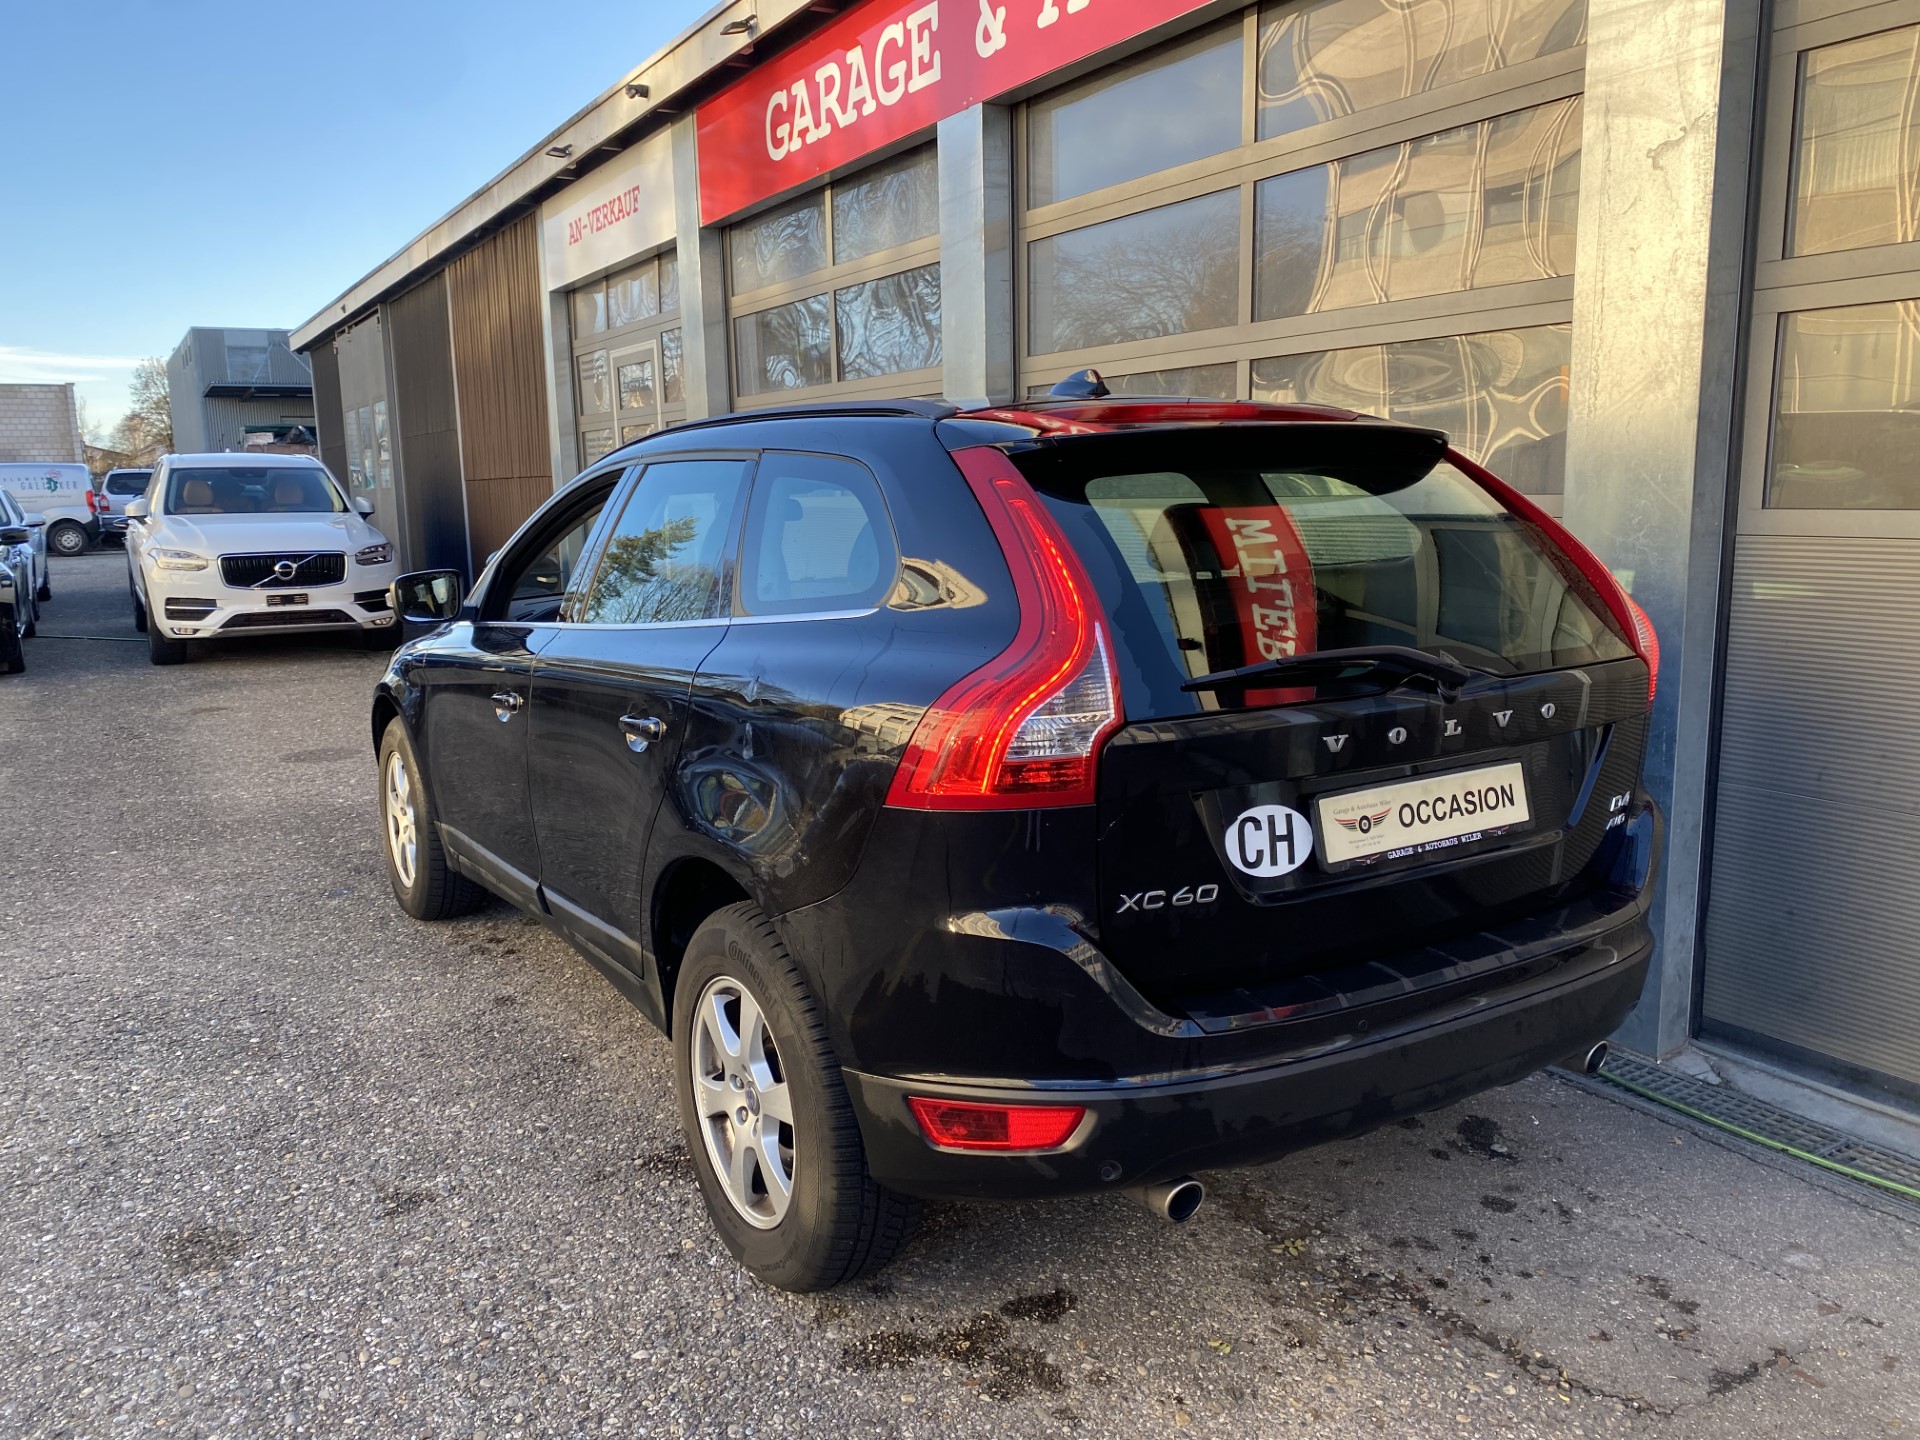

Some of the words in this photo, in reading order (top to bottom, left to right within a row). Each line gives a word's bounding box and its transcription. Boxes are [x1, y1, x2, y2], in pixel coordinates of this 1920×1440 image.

[765, 0, 942, 161] GARAGE
[568, 184, 641, 246] AN-VERKAUF
[1322, 702, 1556, 753] VOLVO
[1398, 783, 1516, 829] OCCASION
[1237, 813, 1297, 870] CH
[1387, 846, 1413, 859] GARAGE
[1417, 845, 1423, 853] &
[1425, 837, 1459, 852] AUTOHAUS
[1461, 832, 1483, 844] WILER
[728, 940, 777, 1009] Continental
